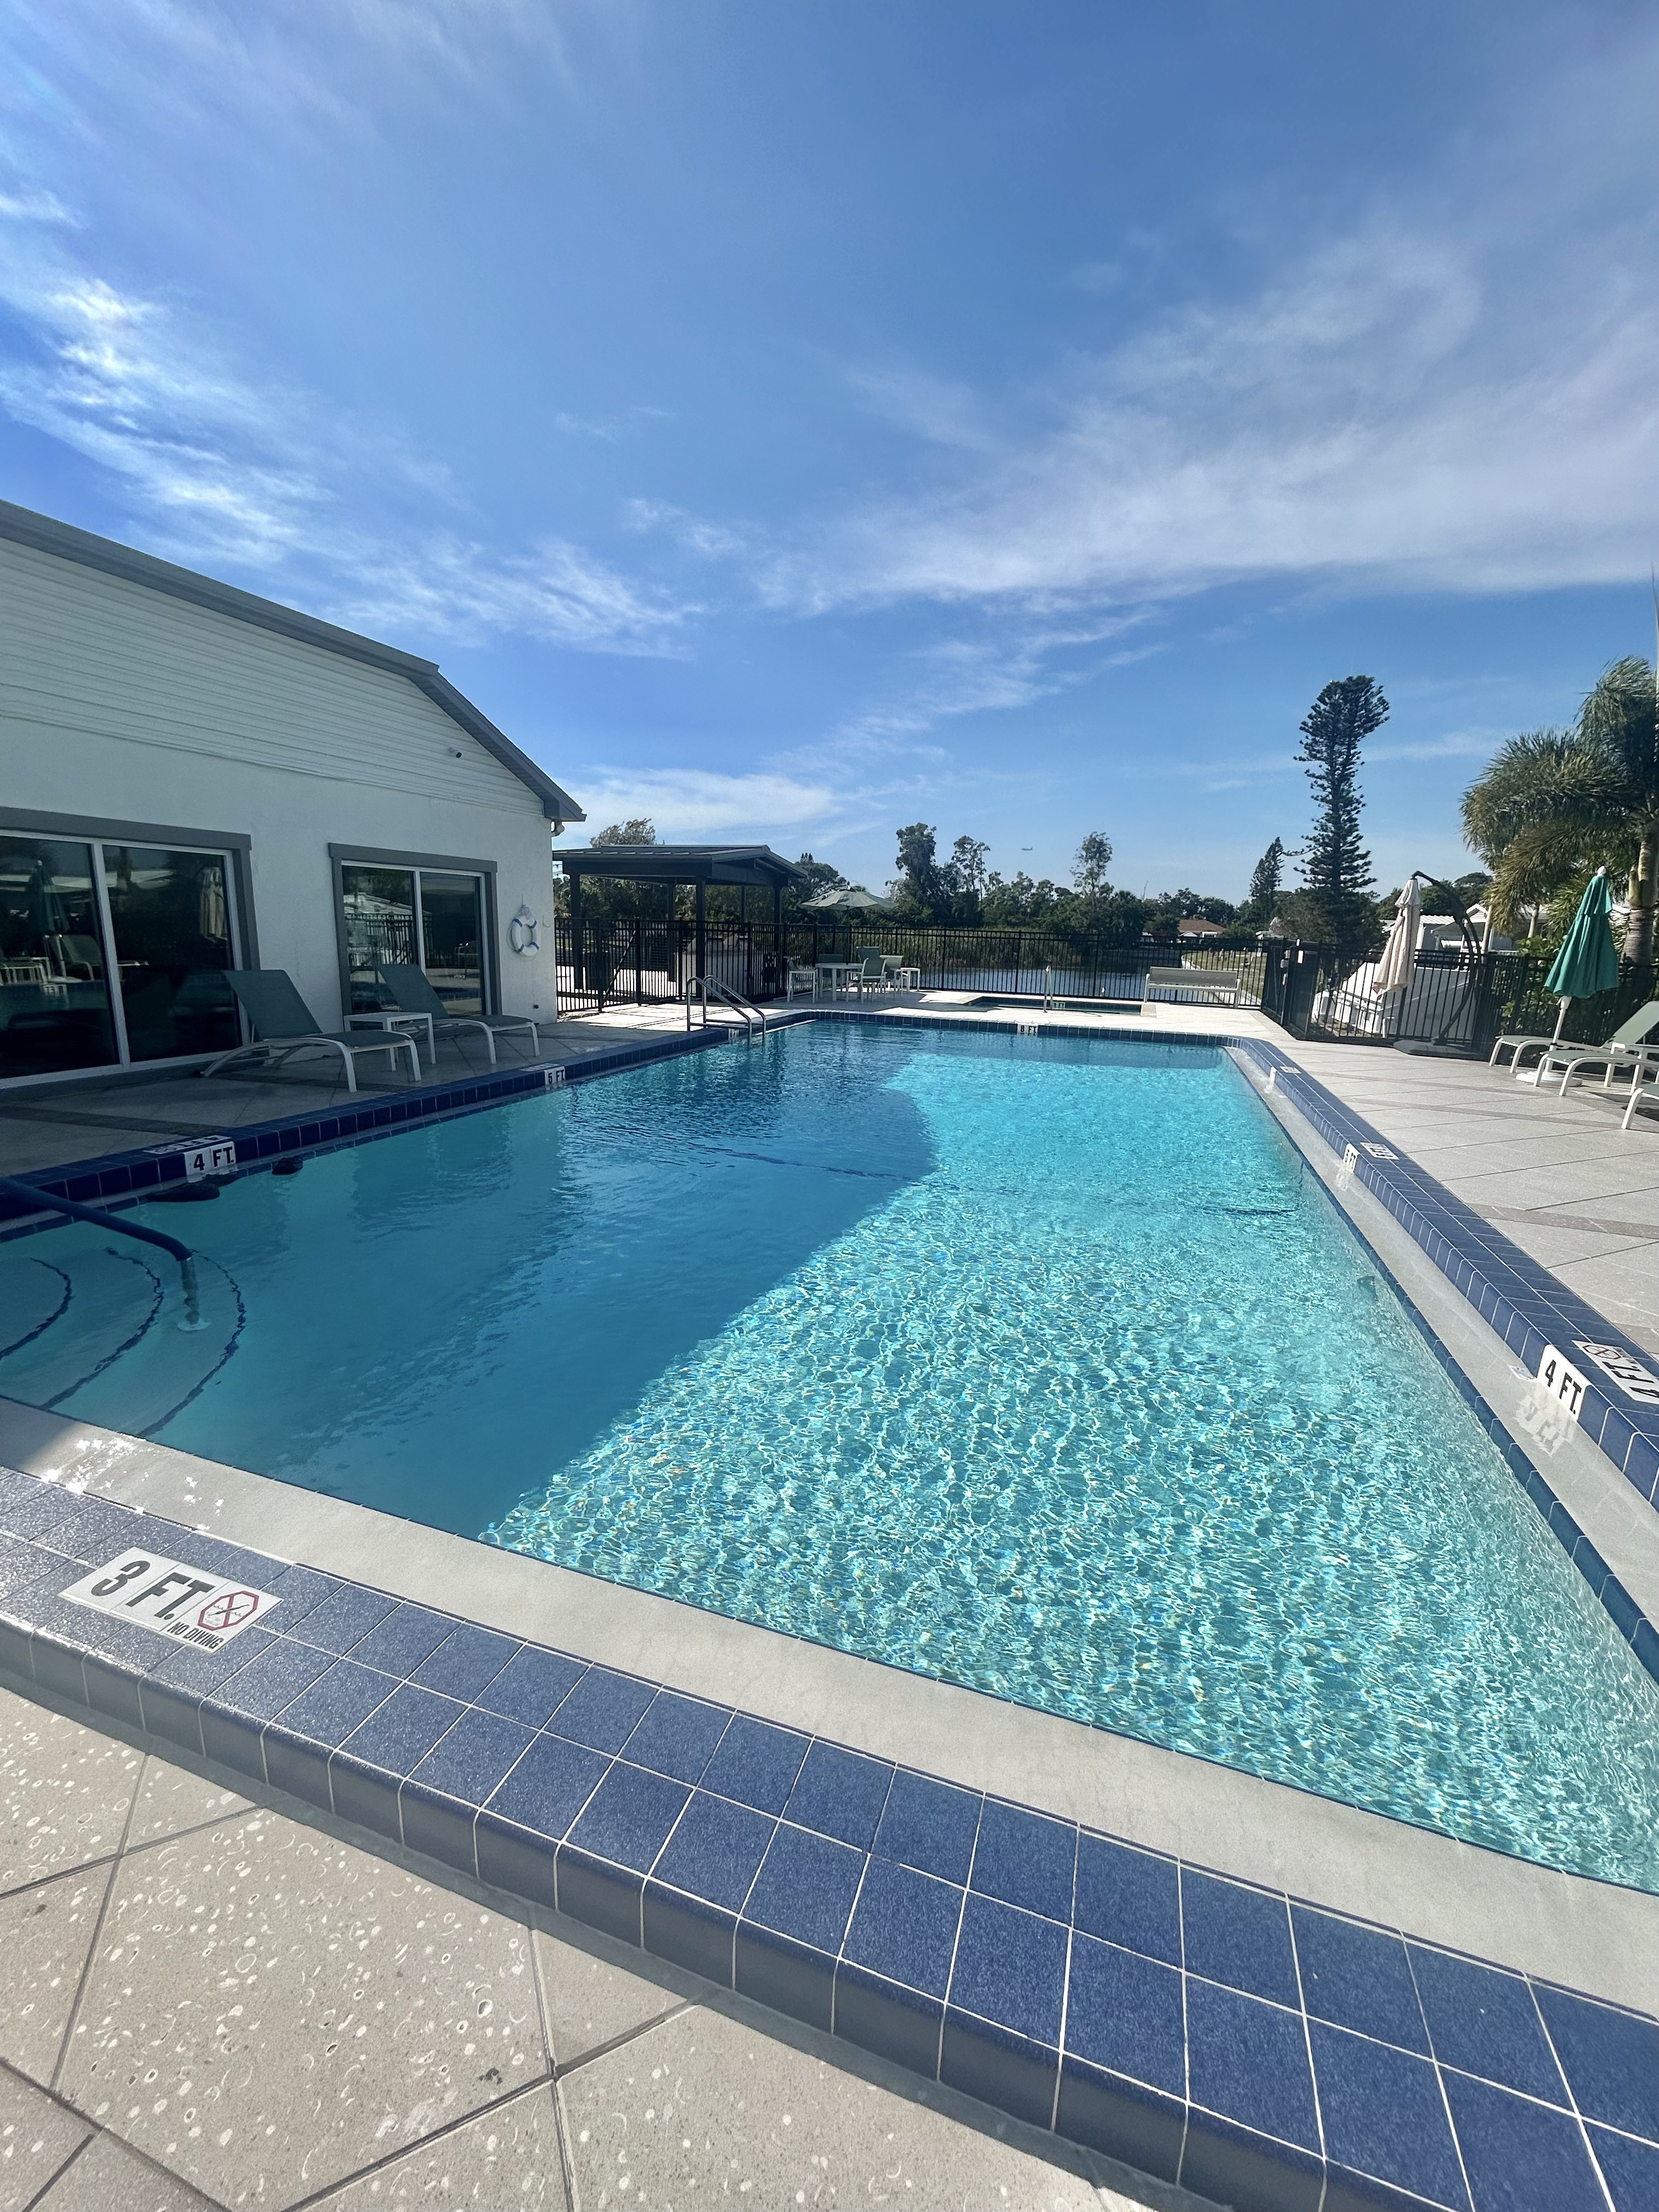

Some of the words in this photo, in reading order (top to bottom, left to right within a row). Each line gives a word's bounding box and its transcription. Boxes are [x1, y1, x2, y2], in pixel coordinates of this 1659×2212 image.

[548, 1072, 553, 1084] 5
[194, 1153, 205, 1171] 4
[212, 1146, 234, 1167] FT.
[1345, 1149, 1350, 1163] 5
[1545, 1359, 1557, 1388] 4
[1559, 1372, 1582, 1415] FT.
[91, 1560, 151, 1596] 3
[125, 1571, 216, 1621] FT.
[166, 1621, 190, 1635] NO
[182, 1627, 224, 1649] DIVING
